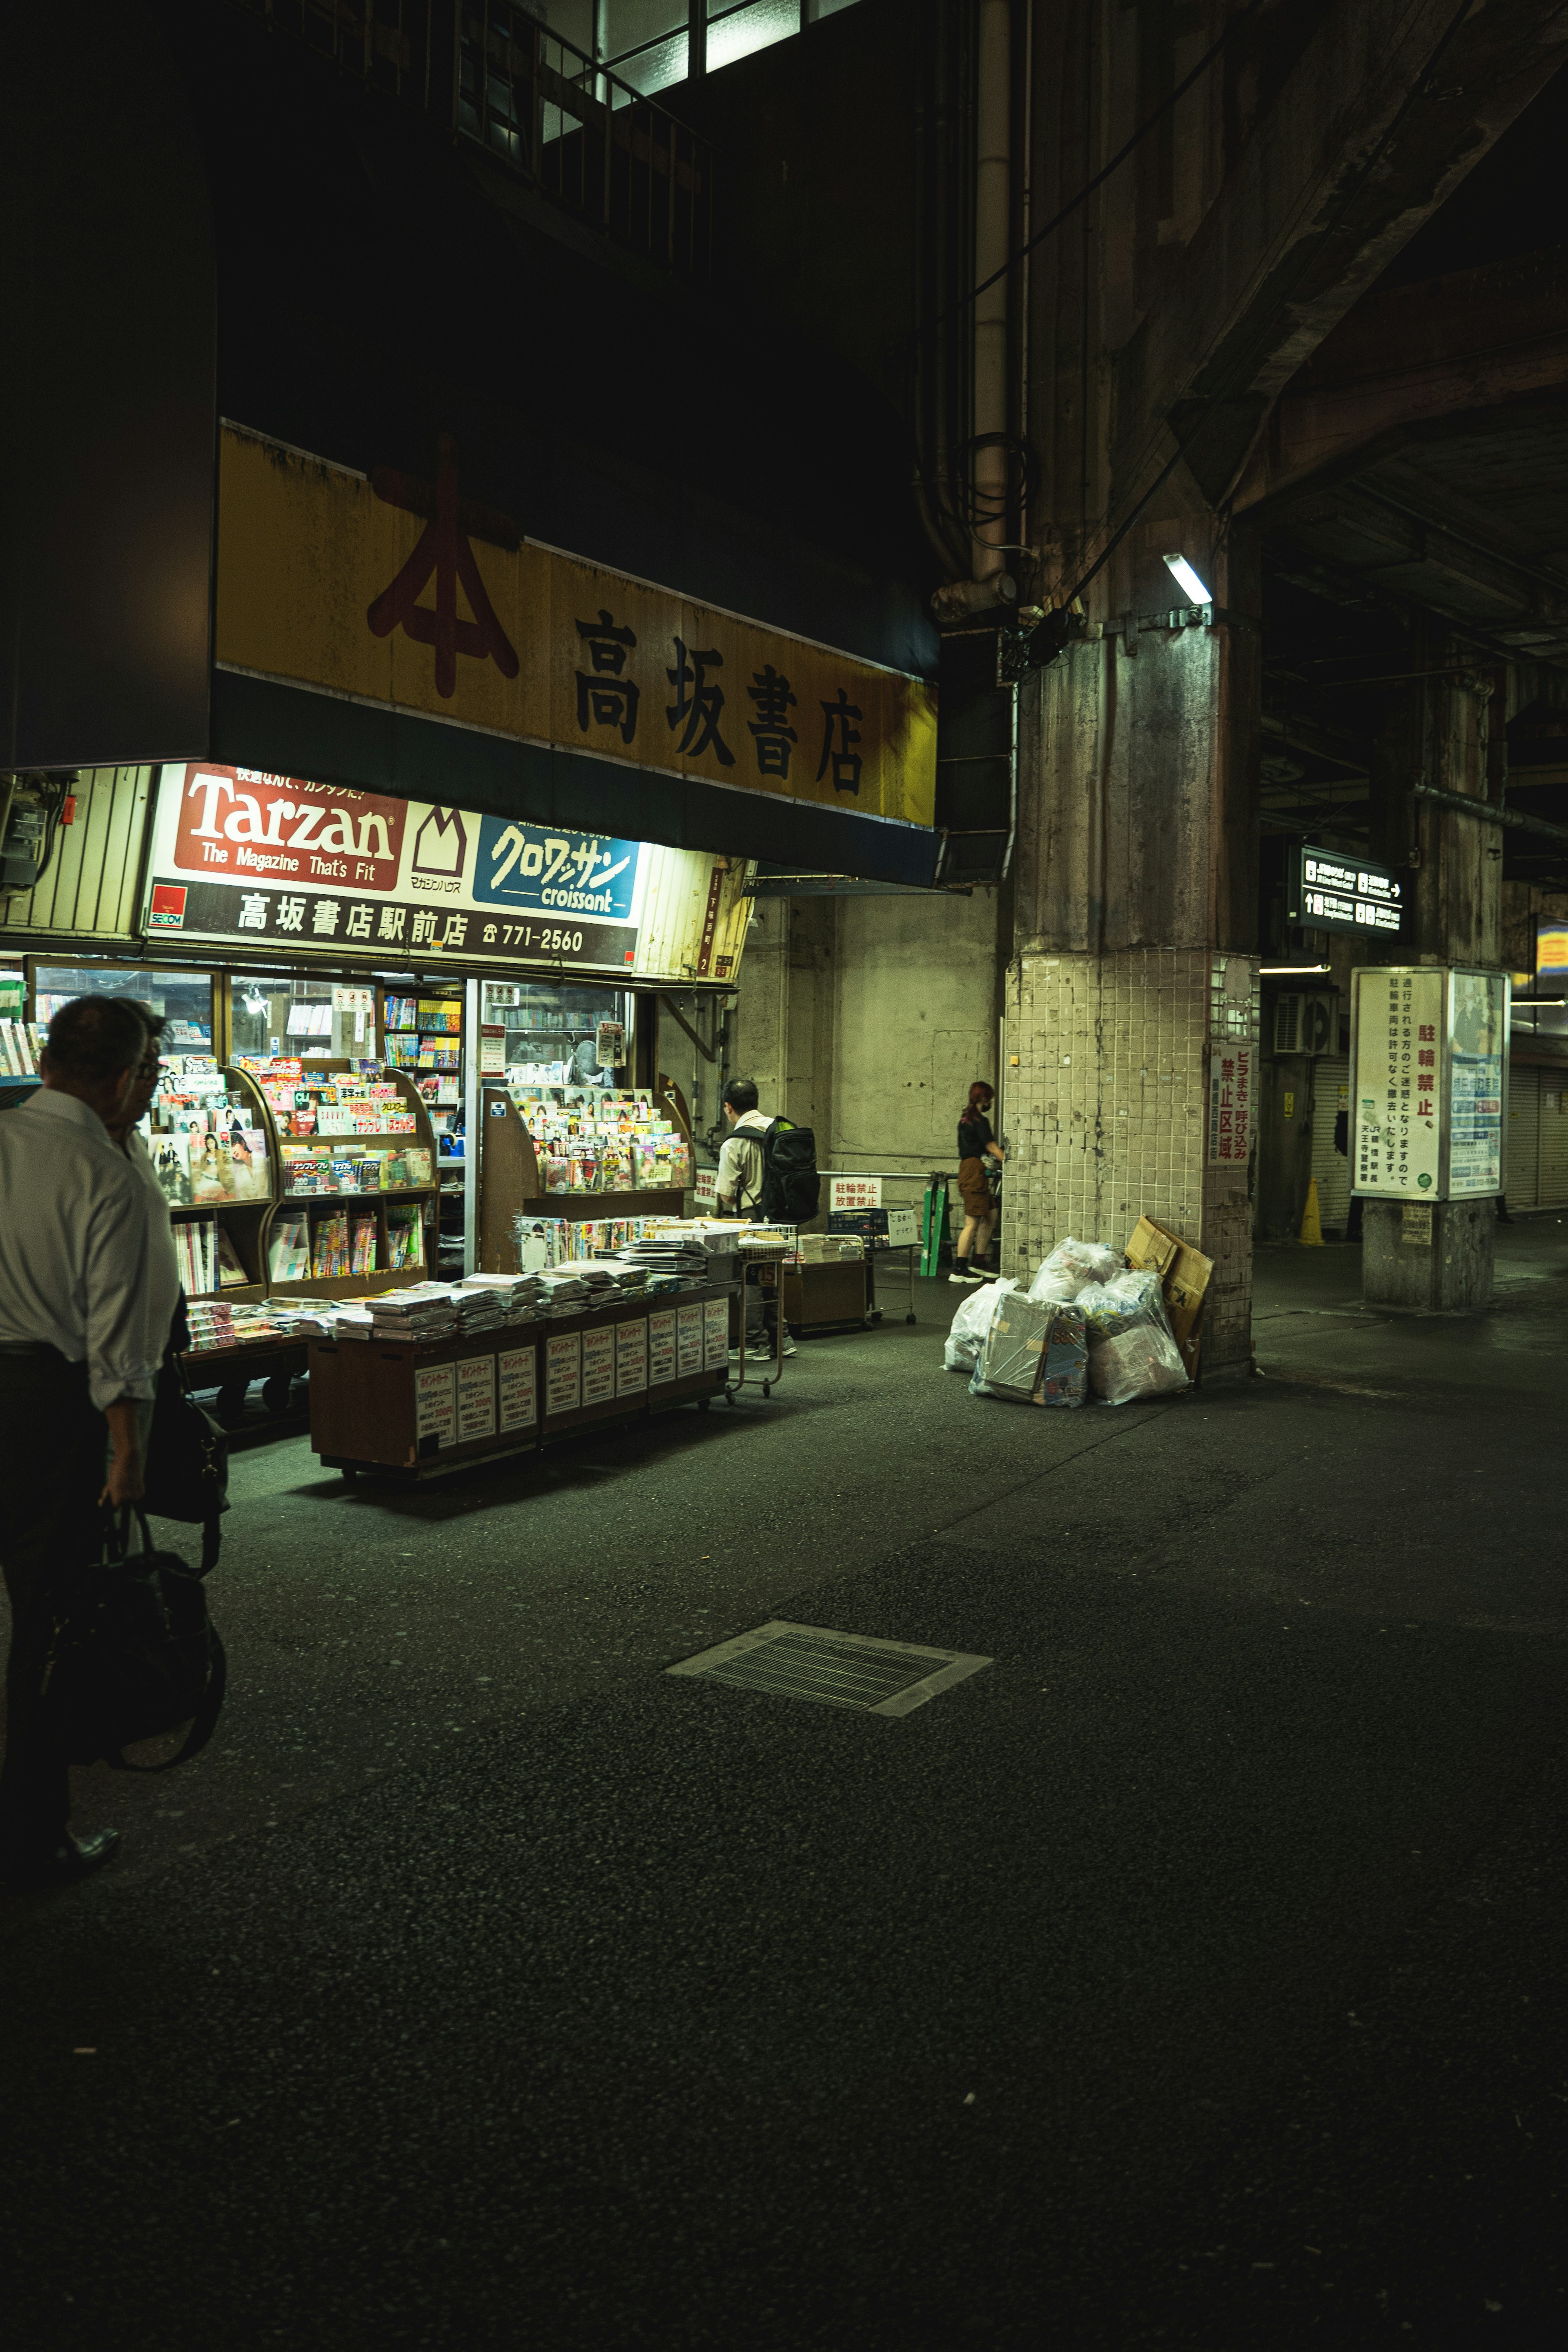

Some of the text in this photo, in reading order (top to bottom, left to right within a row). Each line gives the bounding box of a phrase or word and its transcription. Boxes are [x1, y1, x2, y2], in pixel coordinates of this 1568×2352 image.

[367, 431, 523, 699] 本
[574, 608, 864, 797] 高坂書店
[188, 773, 394, 860] Tarzan
[203, 842, 376, 881] The Magazine That's Fit
[490, 825, 631, 889] クロワッサン
[411, 876, 461, 893] マガジンハウス
[541, 884, 613, 913] croissant
[151, 913, 181, 925] SECOM
[238, 893, 583, 951] 高坂書店駅前店 771-2560
[704, 898, 717, 944] 下味原町
[701, 958, 707, 970] 2
[1417, 1024, 1435, 1116] 駐輪禁止
[1219, 1058, 1235, 1159] 禁止区域
[836, 1183, 877, 1193] 駐輪禁止
[836, 1196, 877, 1206] 放置禁止
